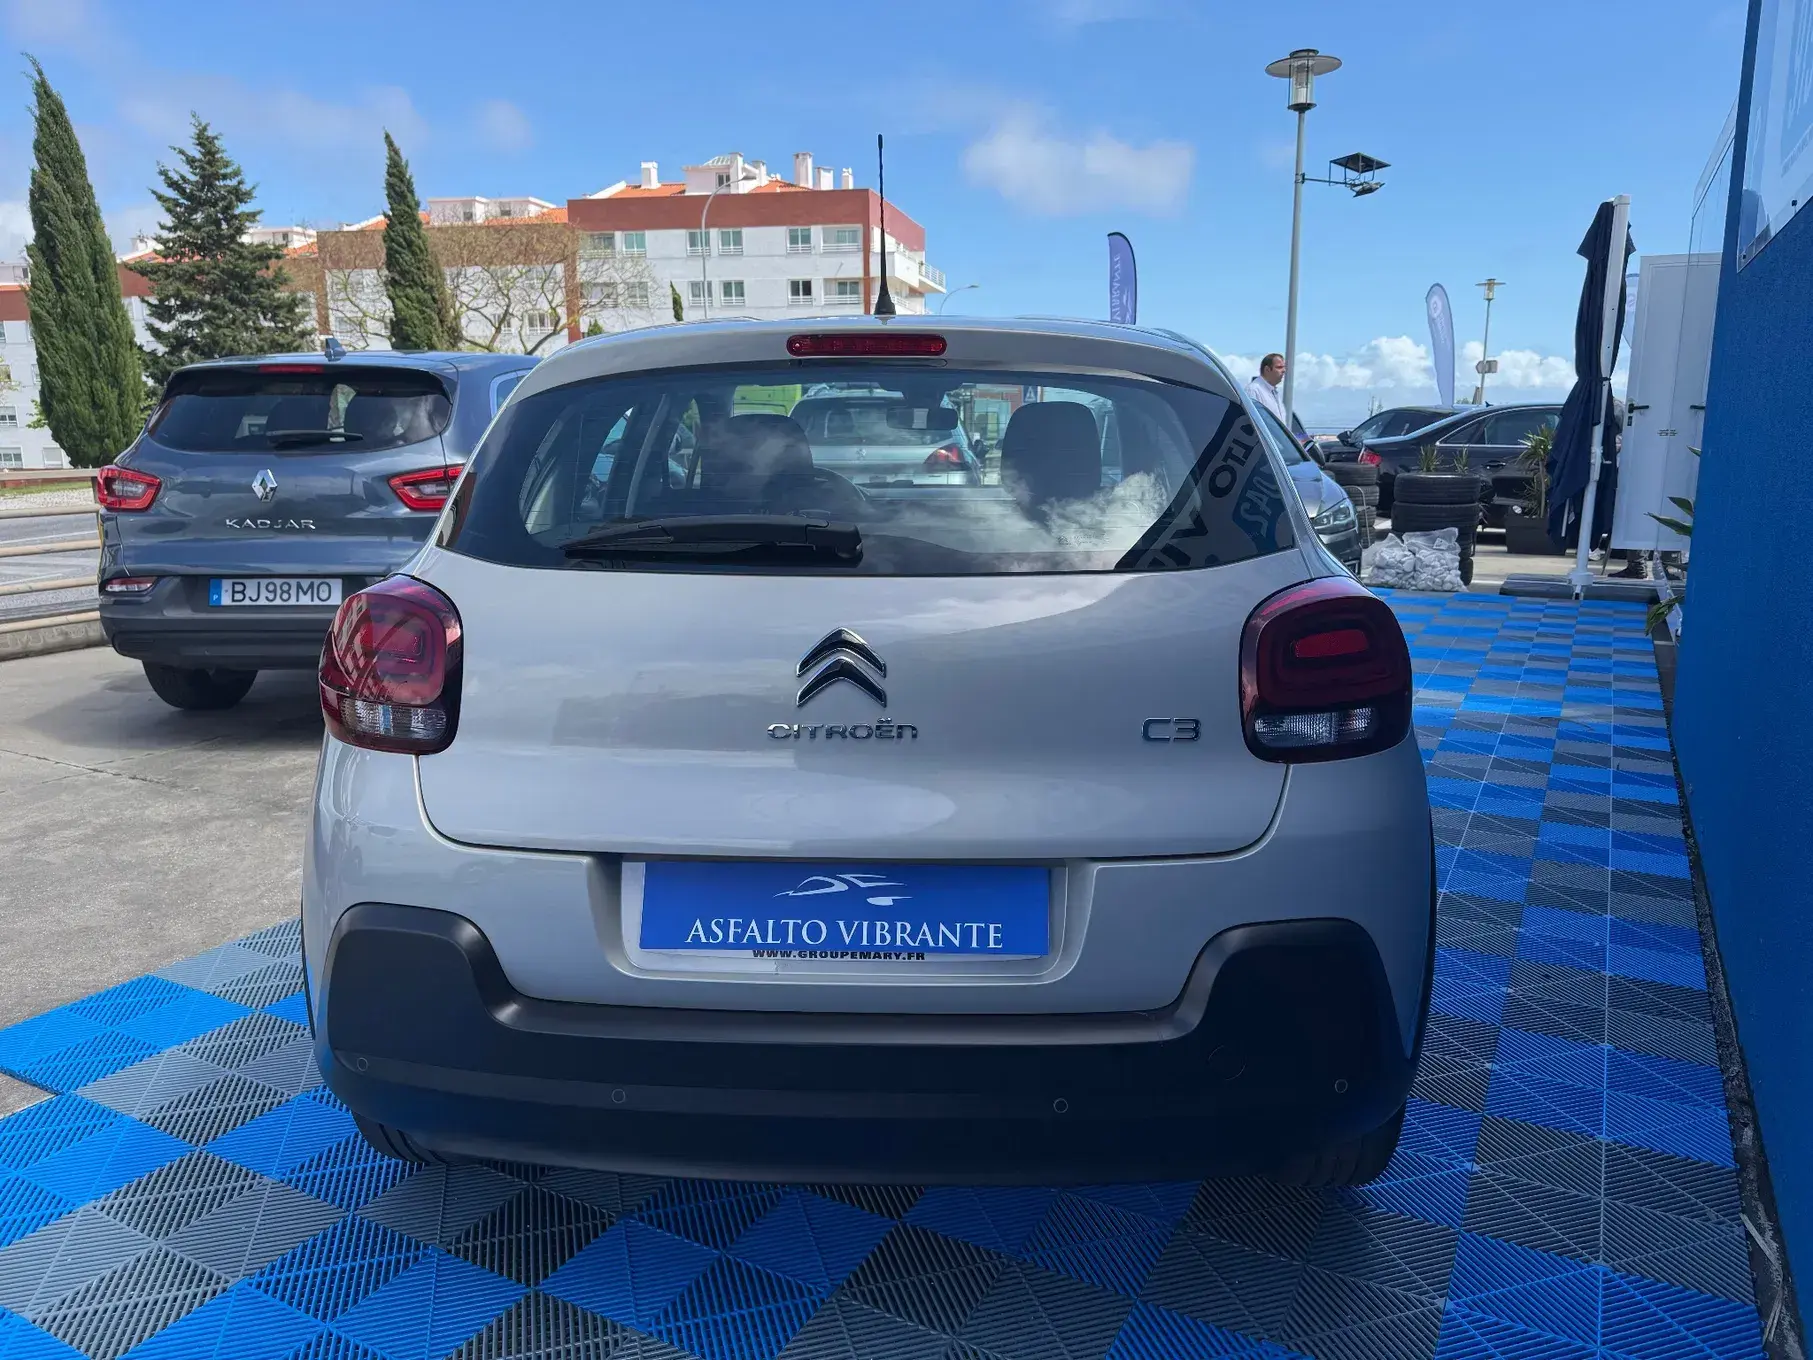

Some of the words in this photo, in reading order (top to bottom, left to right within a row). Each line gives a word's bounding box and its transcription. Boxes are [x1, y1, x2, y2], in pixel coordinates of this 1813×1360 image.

[225, 519, 316, 529] KADJAR
[1142, 717, 1201, 742] C3
[685, 918, 827, 945] ASFALTO
[836, 921, 1003, 949] VIBRANTE
[752, 949, 925, 961] WWW.GROUPEMARY.FR
